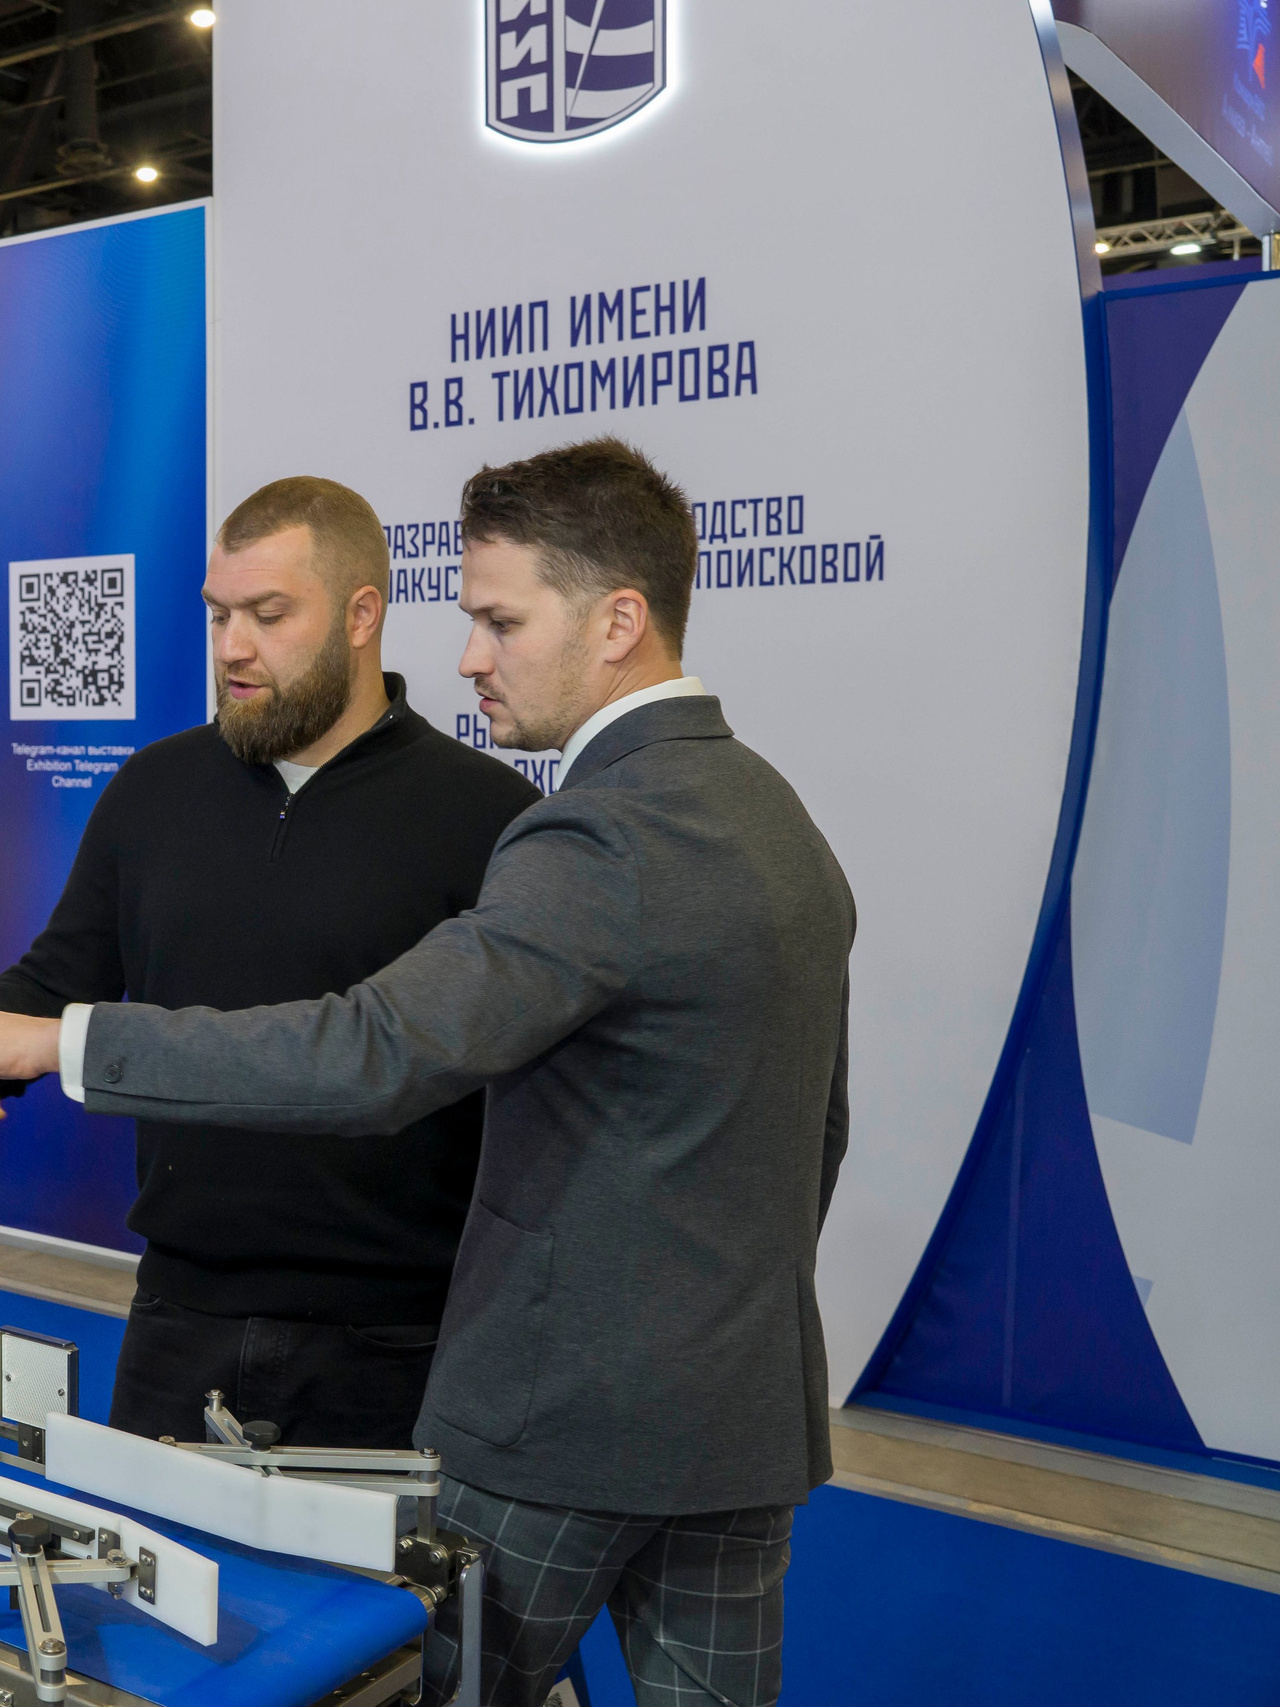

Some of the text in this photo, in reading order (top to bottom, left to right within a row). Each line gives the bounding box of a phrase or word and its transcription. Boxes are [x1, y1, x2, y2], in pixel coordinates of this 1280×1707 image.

[451, 277, 706, 363] НИИП ИМЕНИ
[409, 340, 758, 432] В.В. ТИХОМИРОВА
[692, 495, 805, 545] ОДСТВО
[388, 565, 462, 604] АКУС
[26, 759, 119, 774] Exhibition Telegram
[51, 775, 92, 788] Channel
